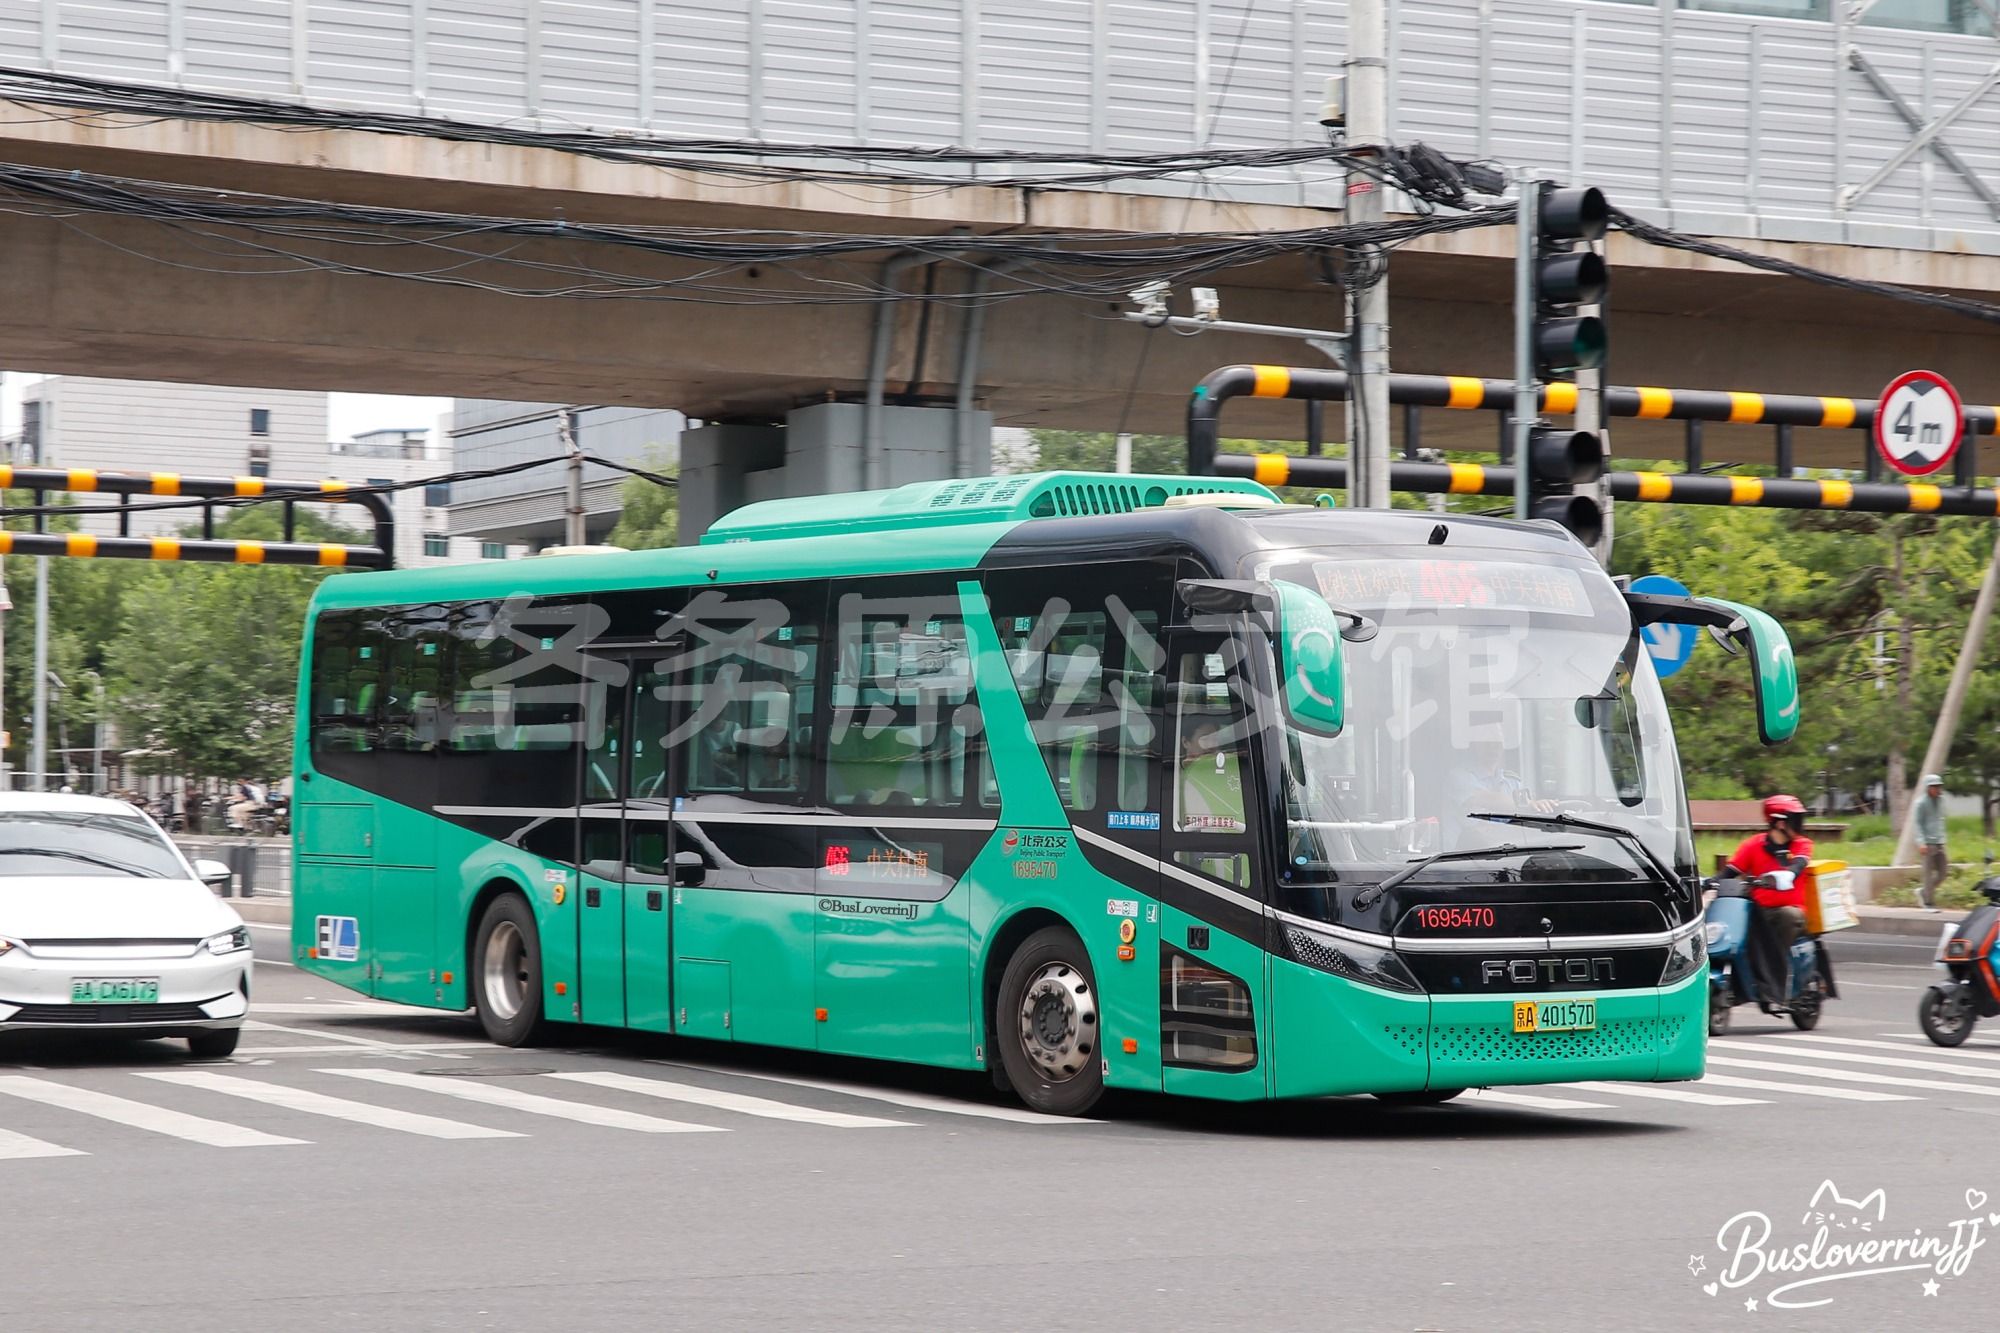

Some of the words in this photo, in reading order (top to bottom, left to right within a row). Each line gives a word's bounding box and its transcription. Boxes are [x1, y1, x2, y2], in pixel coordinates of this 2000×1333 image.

[1419, 560, 1488, 605] 466
[1488, 570, 1576, 608] 中关村南
[1021, 835, 1068, 848] 北京公交
[866, 848, 928, 879] 中关村南
[1012, 860, 1057, 879] 1695470
[1417, 908, 1494, 928] 1695470
[1481, 957, 1616, 984] FOTON
[1541, 1003, 1594, 1026] 40157D
